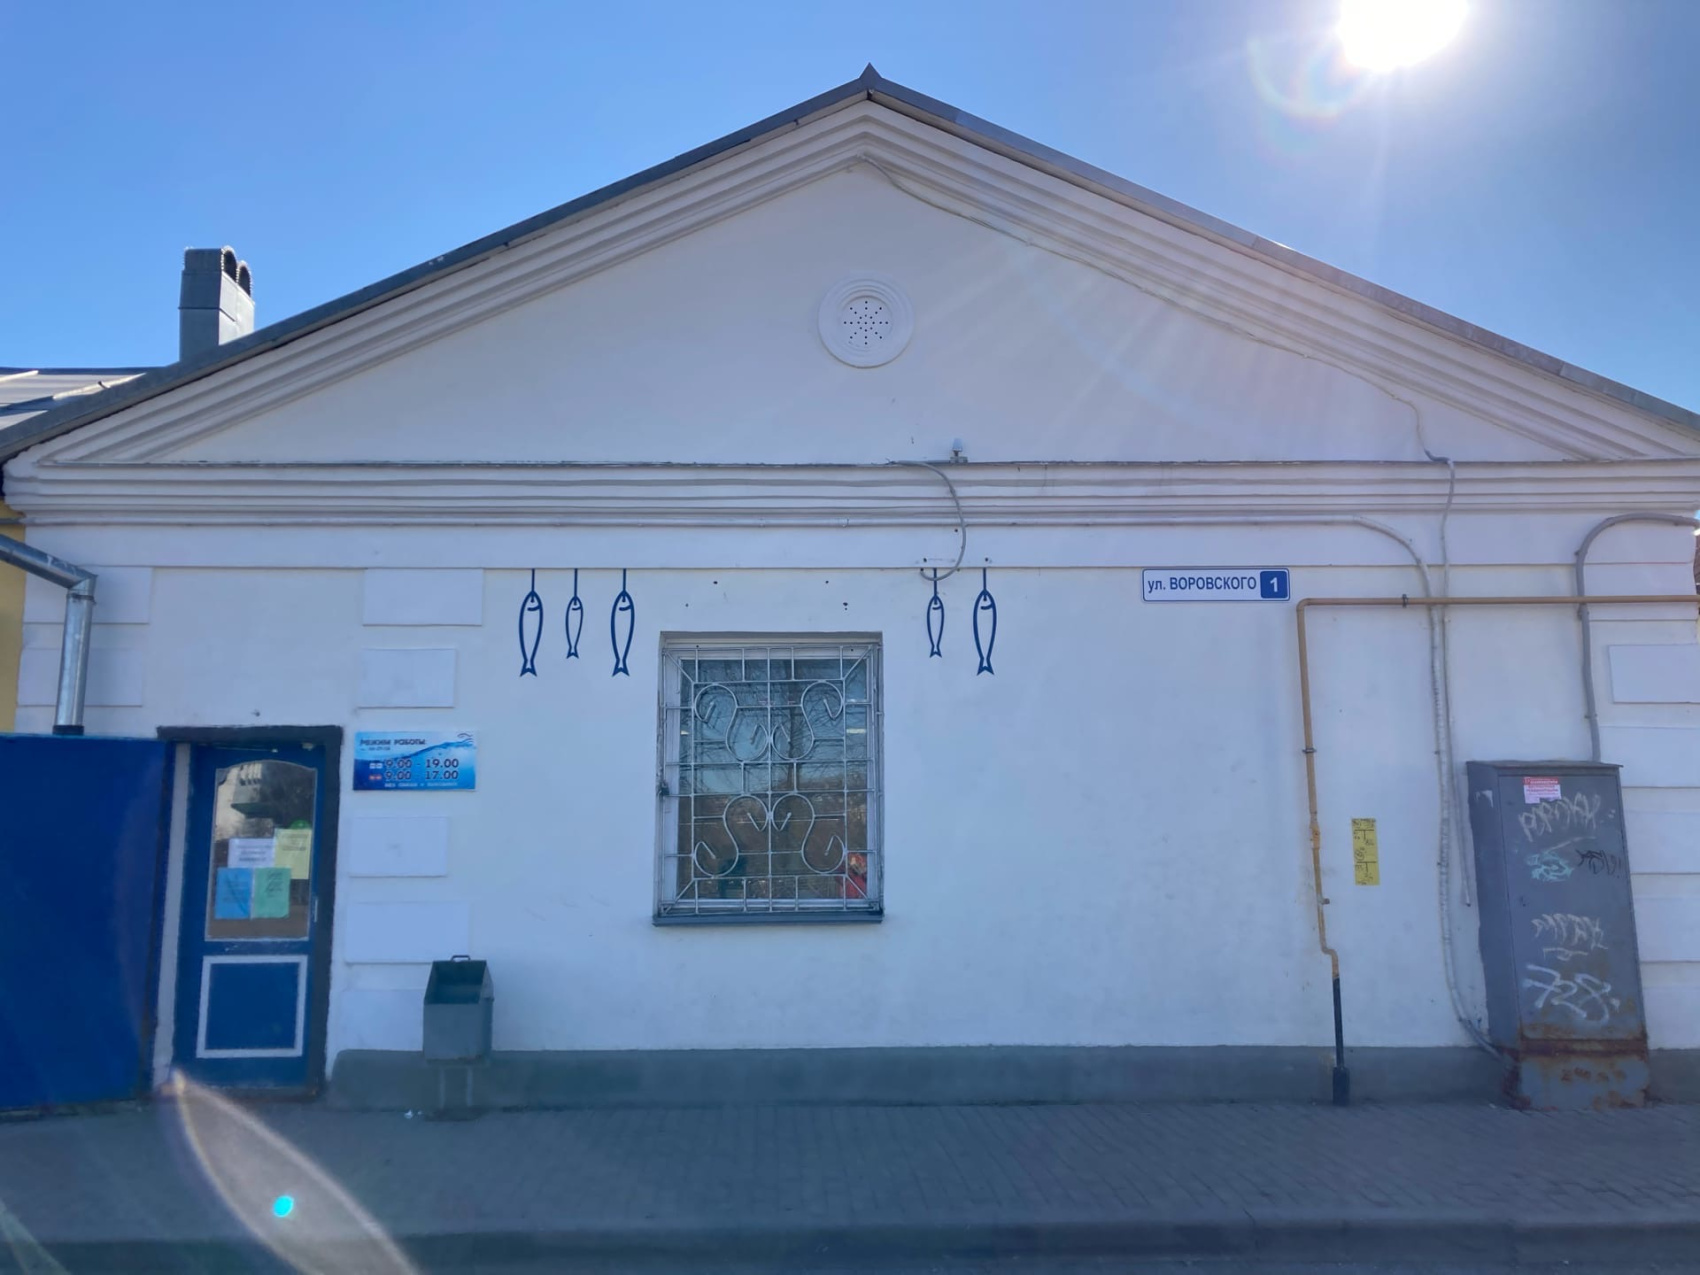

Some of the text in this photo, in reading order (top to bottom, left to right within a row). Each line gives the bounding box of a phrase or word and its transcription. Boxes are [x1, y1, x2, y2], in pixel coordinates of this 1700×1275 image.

[1147, 576, 1279, 594] ул. ВОРОВСКОГО 1
[384, 758, 412, 769] 9.00
[425, 758, 459, 769] 19.00
[384, 770, 412, 780] 9.00
[425, 770, 459, 780] 17.00
